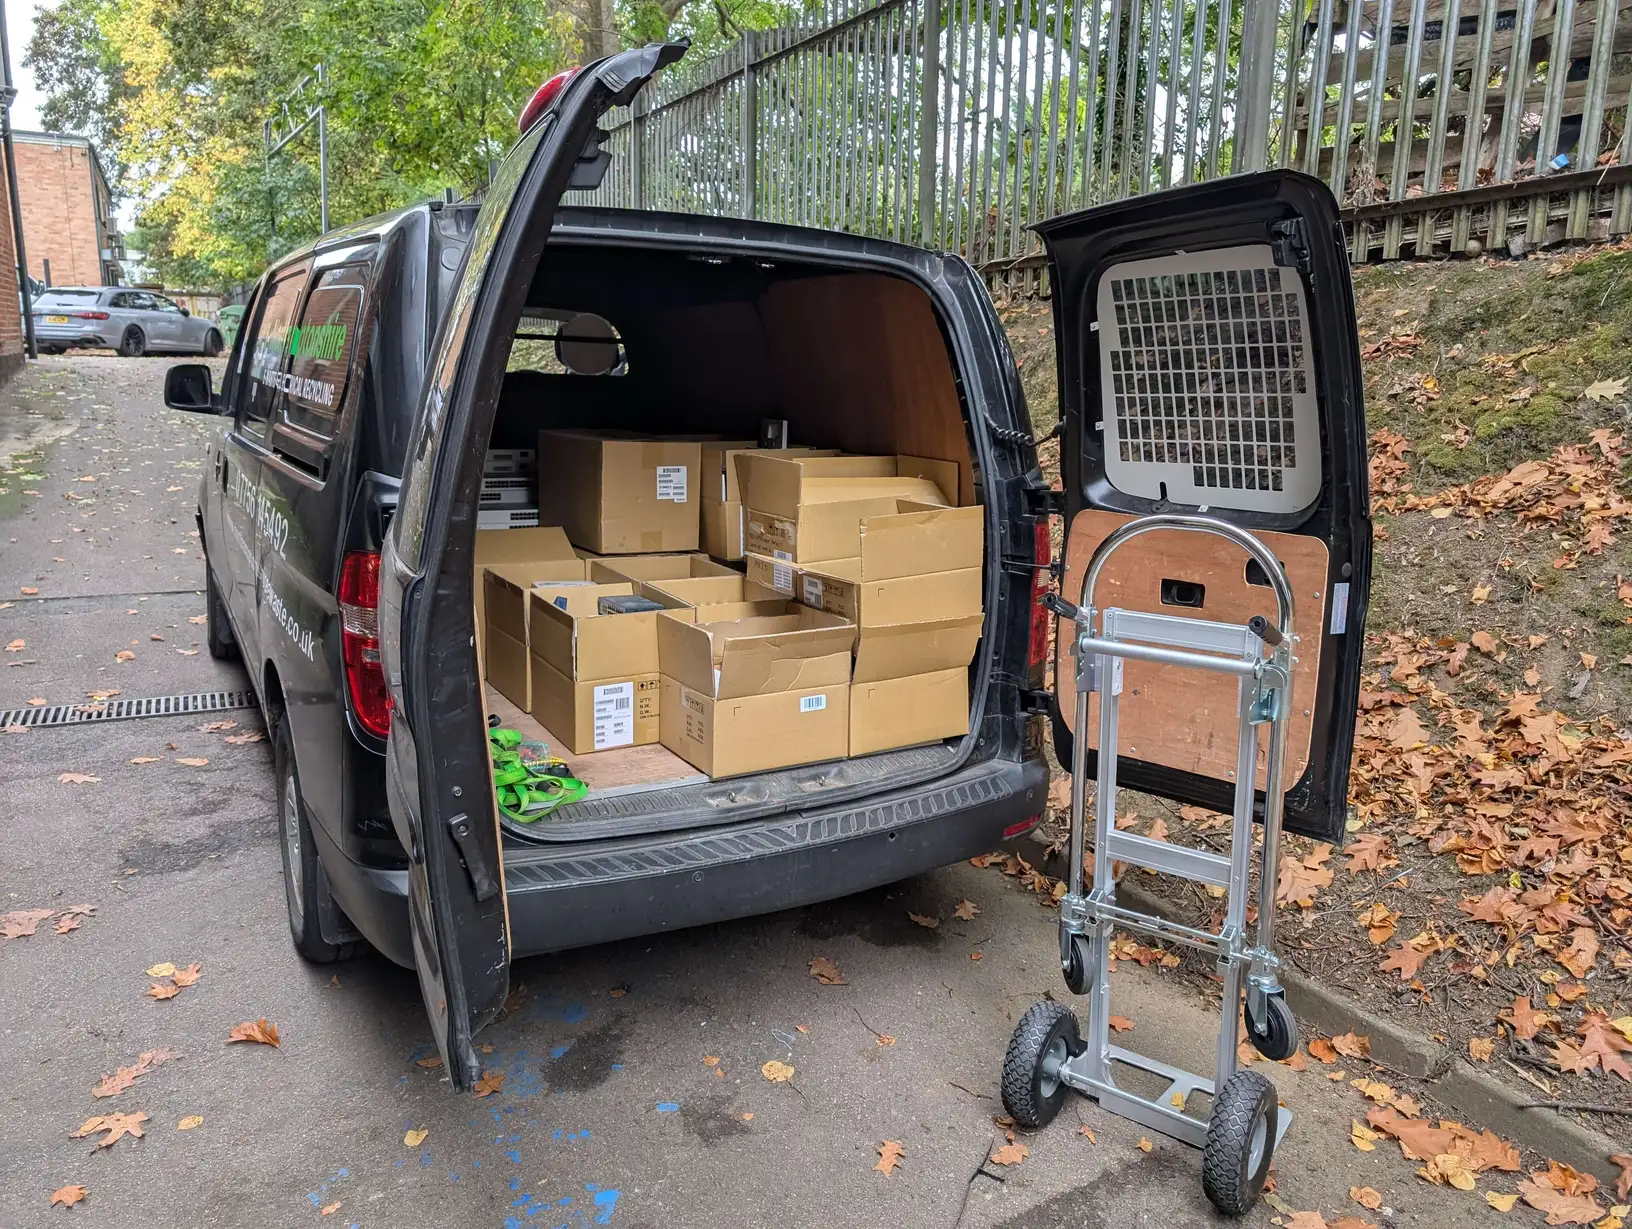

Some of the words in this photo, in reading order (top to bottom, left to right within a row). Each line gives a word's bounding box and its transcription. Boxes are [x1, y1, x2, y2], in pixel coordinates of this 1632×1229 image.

[302, 378, 335, 407] RECYCLING
[234, 468, 256, 519] 07756
[256, 493, 289, 561] 145492
